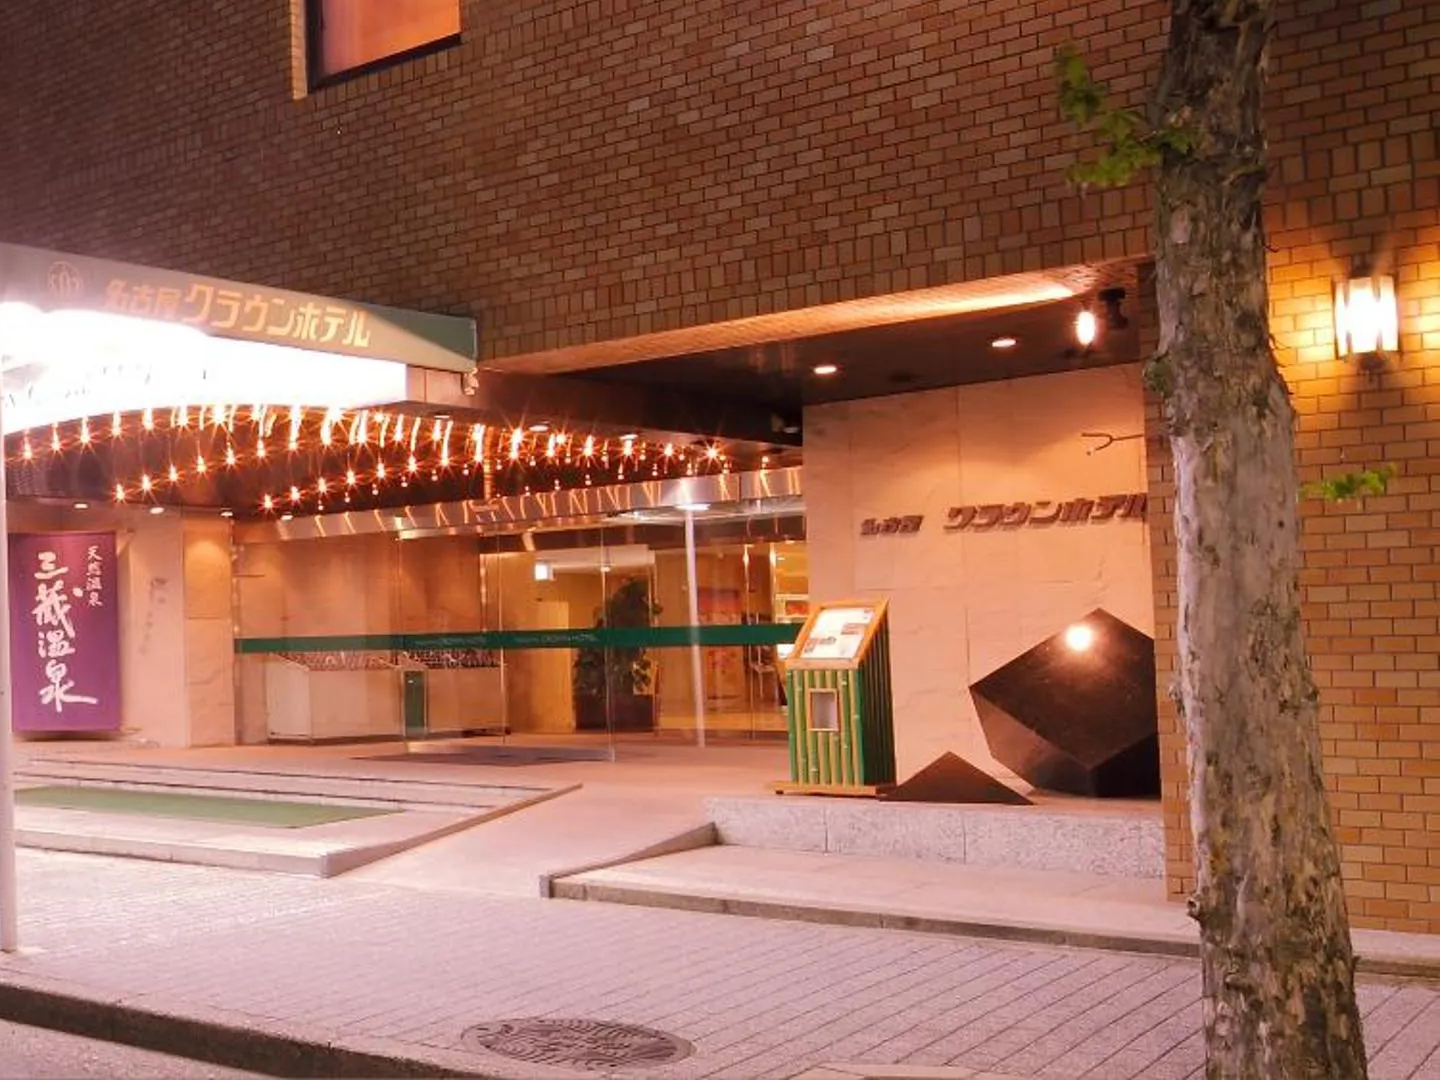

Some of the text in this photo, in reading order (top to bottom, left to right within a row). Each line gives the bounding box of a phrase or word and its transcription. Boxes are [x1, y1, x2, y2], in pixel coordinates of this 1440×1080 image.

[944, 493, 1147, 530] クラウンホテル
